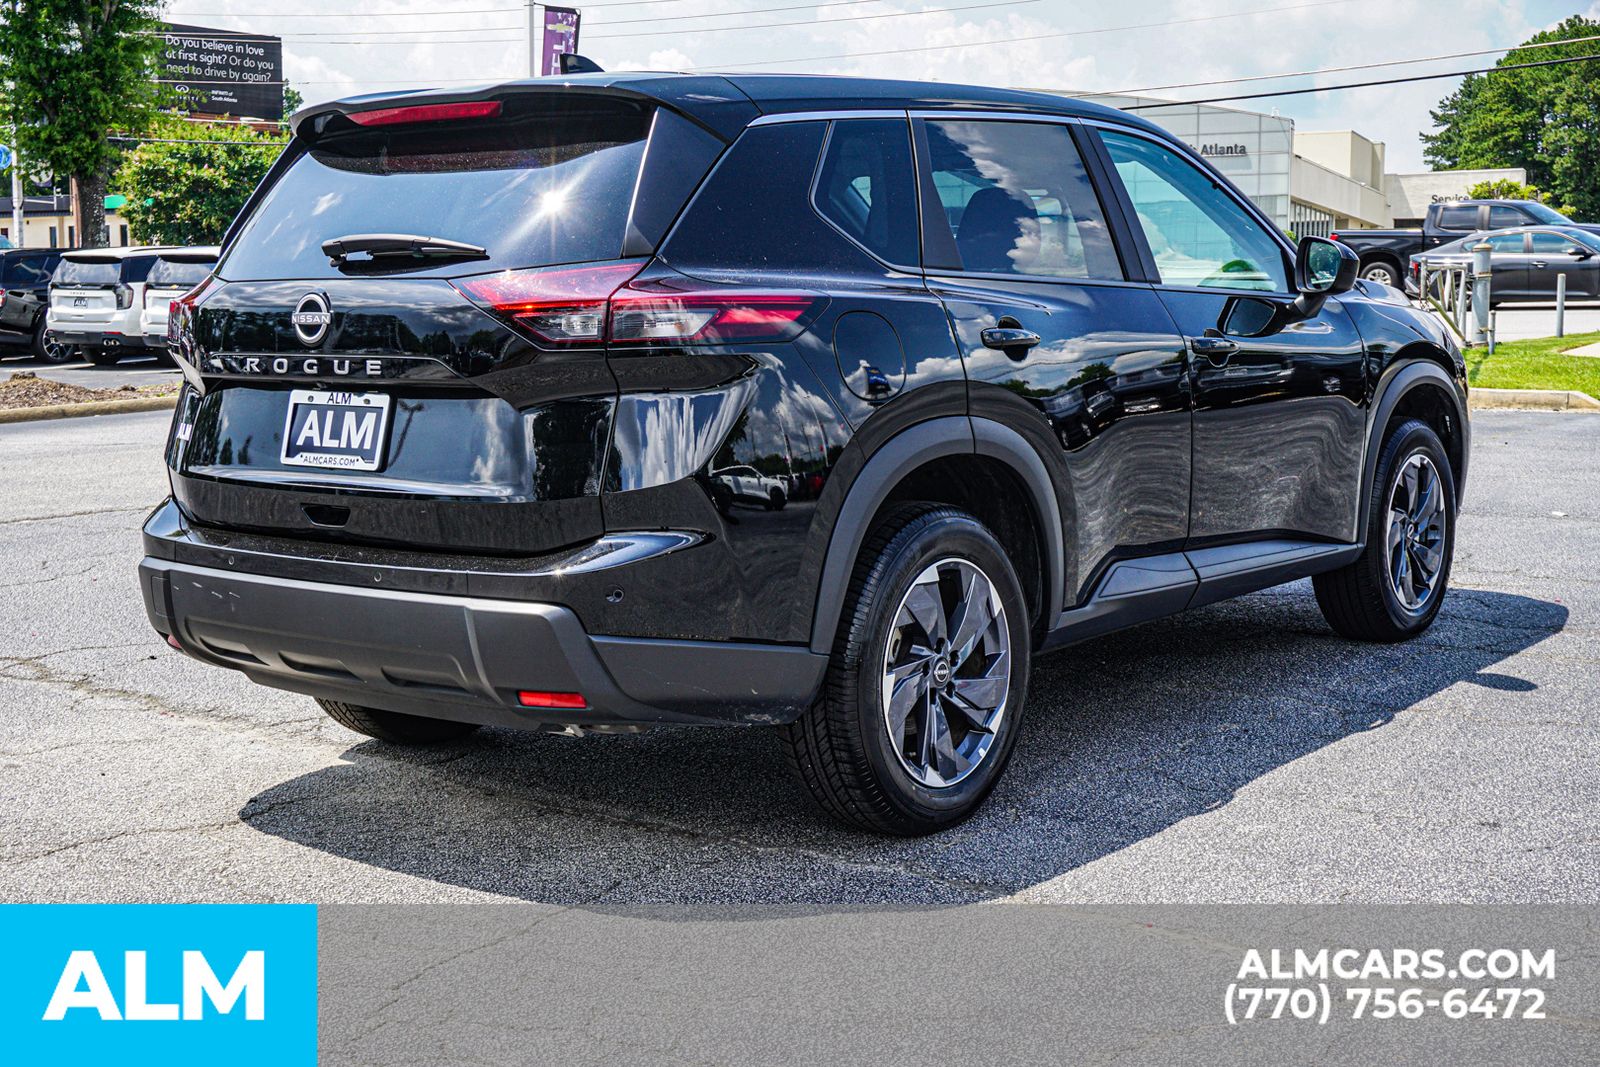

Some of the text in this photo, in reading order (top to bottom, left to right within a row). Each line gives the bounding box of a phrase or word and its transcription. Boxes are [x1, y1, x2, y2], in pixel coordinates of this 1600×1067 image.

[165, 35, 265, 56] Do you believe in love
[165, 49, 274, 71] at first sight? Or do you
[166, 63, 271, 82] need to drive by again?
[1200, 143, 1247, 155] Atlanta
[1431, 194, 1470, 204] Service
[291, 313, 331, 325] NISSAN
[246, 357, 382, 376] ROGUE
[326, 392, 352, 405] ALM
[295, 409, 377, 450] ALM
[302, 455, 356, 467] ALMCARS.COM
